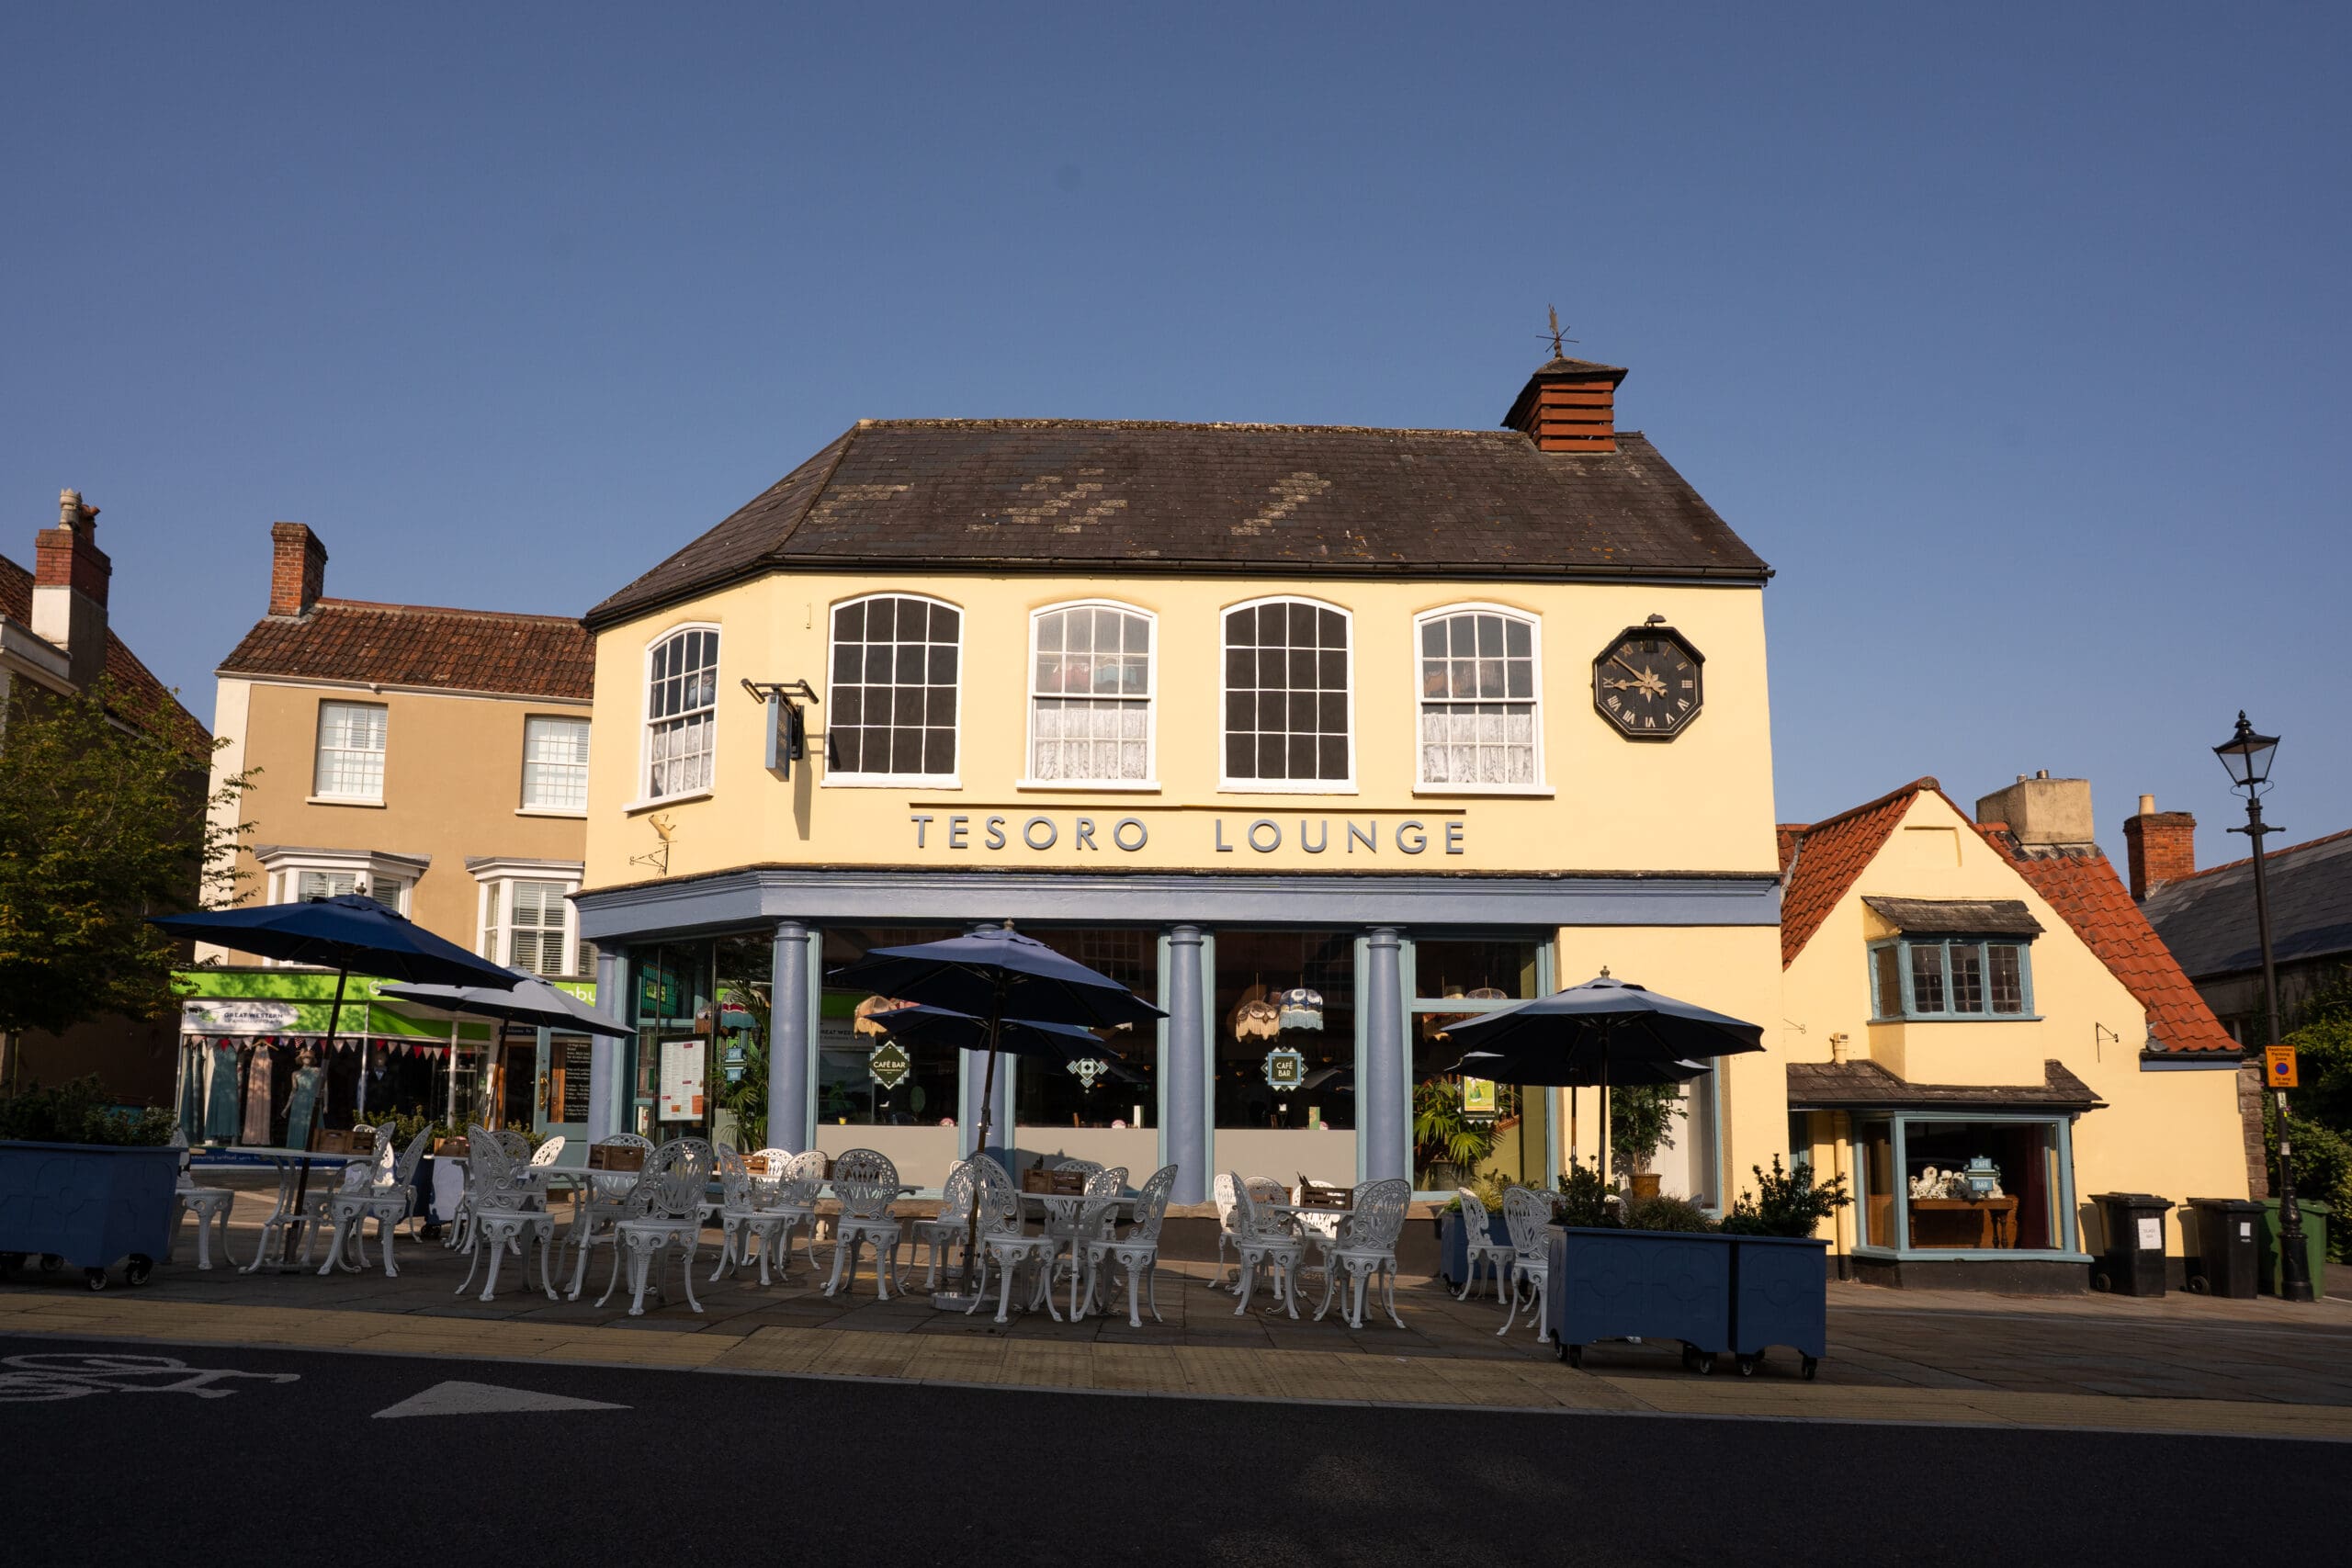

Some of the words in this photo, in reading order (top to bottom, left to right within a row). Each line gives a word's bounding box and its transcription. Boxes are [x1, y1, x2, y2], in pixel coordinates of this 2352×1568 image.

[1681, 680, 1693, 689] III
[1645, 716, 1656, 728] VI
[1666, 712, 1675, 725] V
[911, 816, 1148, 852] TESORO
[1216, 818, 1464, 854] LOUNGE
[873, 1060, 891, 1068] CAFÉ
[1276, 1061, 1294, 1069] CAFÉ
